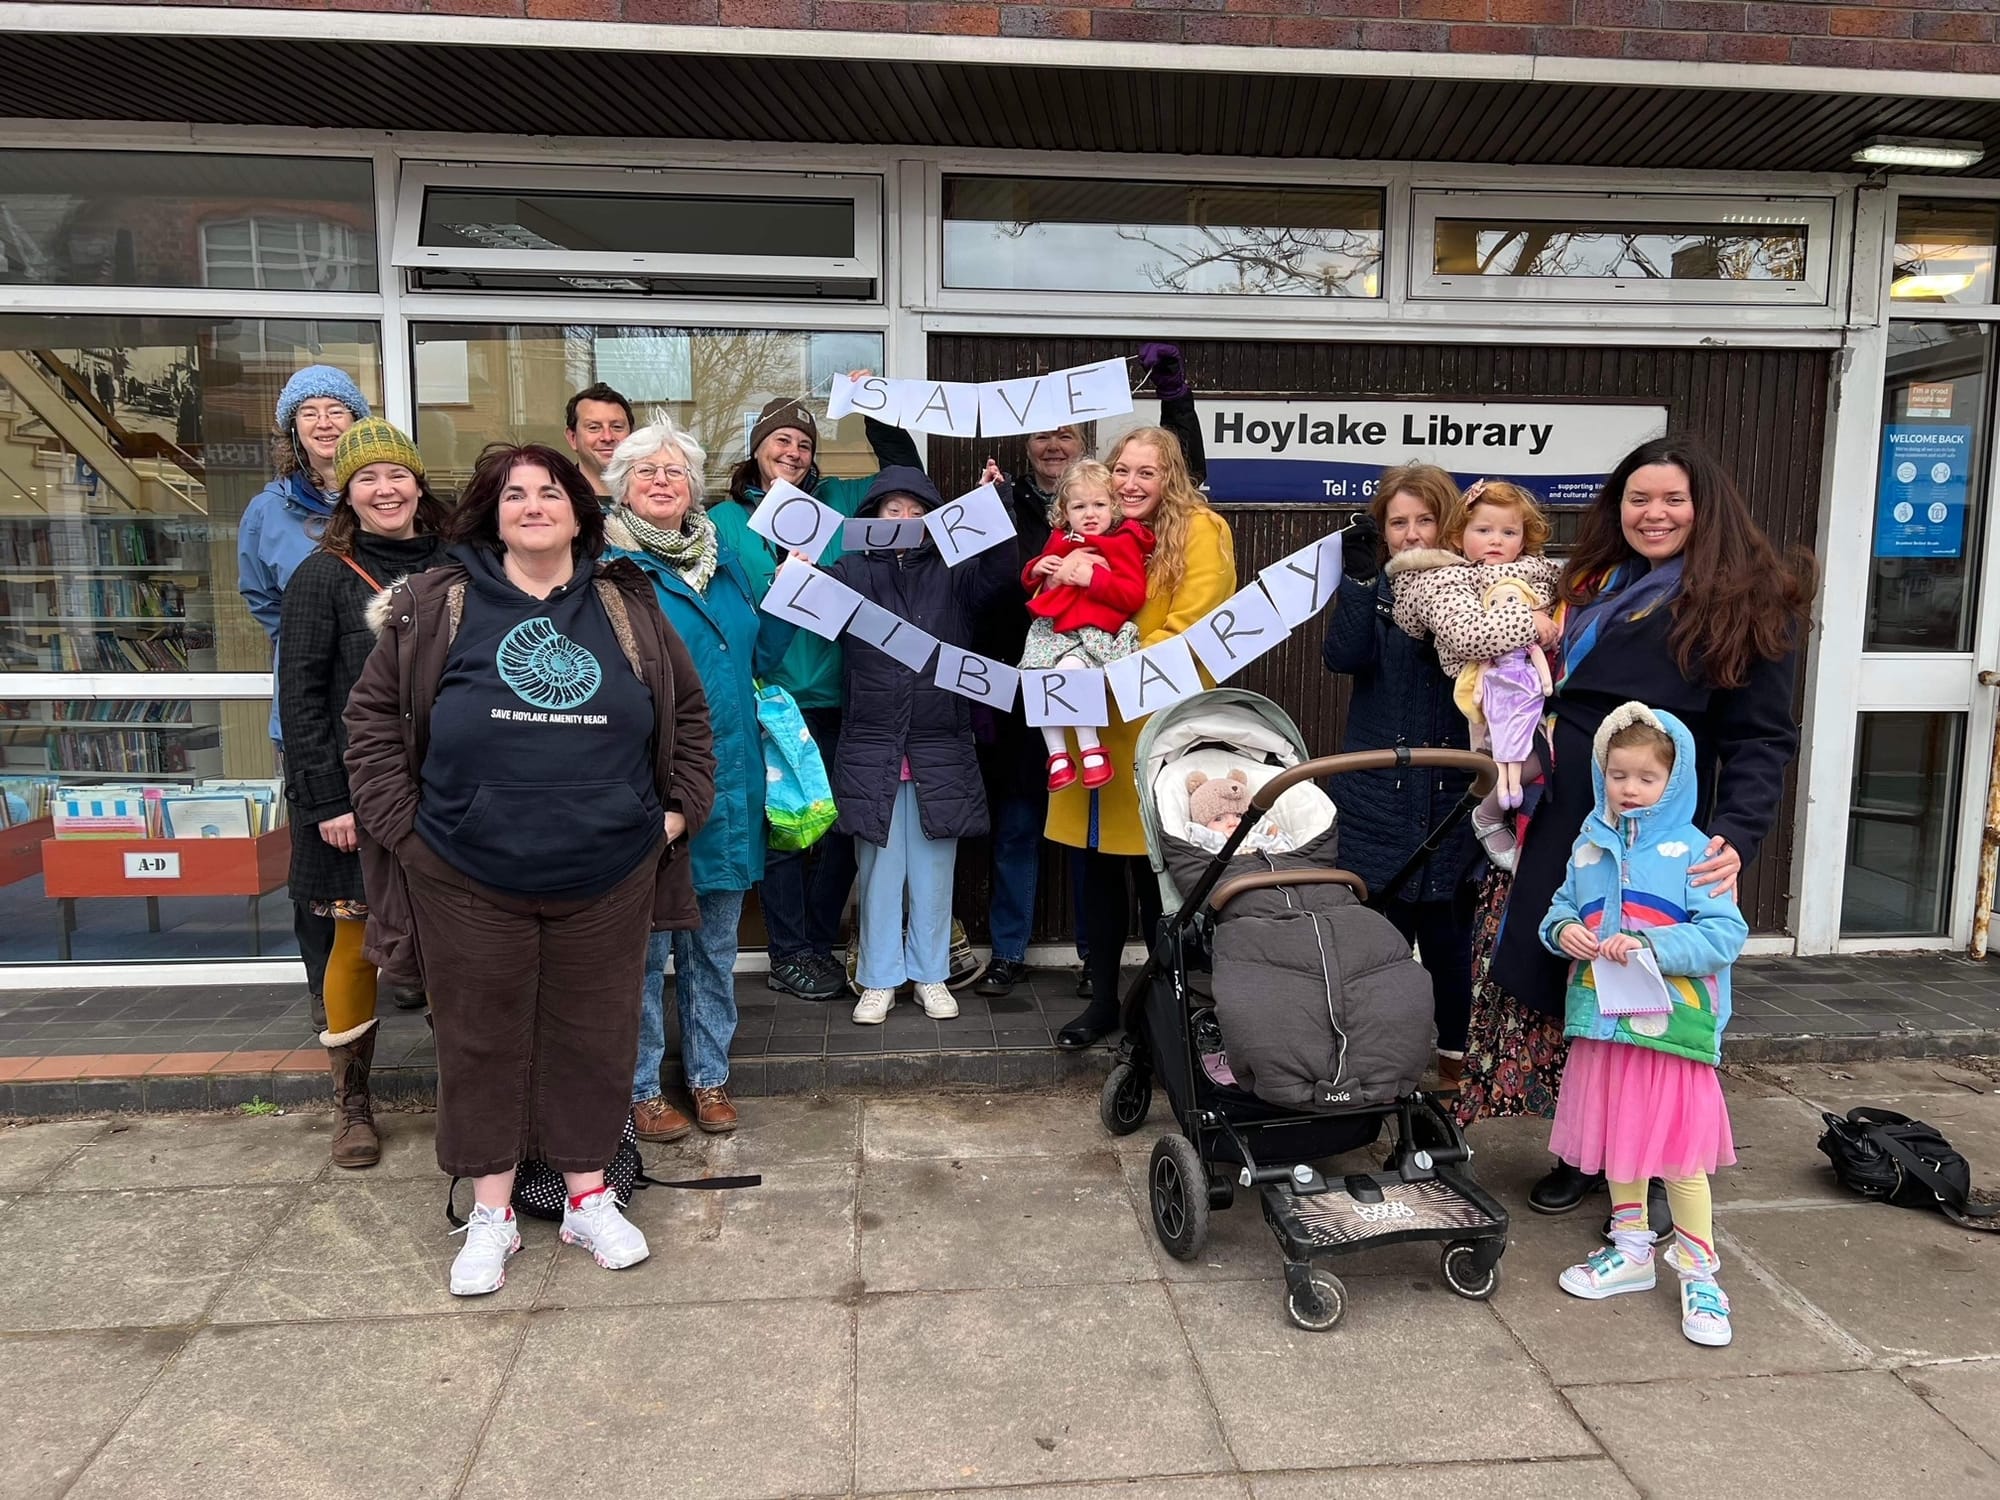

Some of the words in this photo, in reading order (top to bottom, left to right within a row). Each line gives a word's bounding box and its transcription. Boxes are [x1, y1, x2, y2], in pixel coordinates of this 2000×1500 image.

[850, 366, 1106, 432] SAVE
[1214, 411, 1387, 452] Hoylake
[1402, 413, 1553, 454] Library
[1889, 433, 1937, 444] WELCOME
[1938, 434, 1964, 444] BACK
[1322, 479, 1347, 496] Tel
[1558, 483, 1594, 491] supporting
[771, 496, 987, 554] OUR
[786, 542, 1323, 716] LIBRARY
[491, 709, 512, 720] SAVE
[512, 711, 548, 723] HOYLAKE
[549, 714, 582, 725] AMENITY
[583, 715, 608, 725] BEACH
[138, 857, 167, 871] A-D
[1324, 1091, 1351, 1102] Joie
